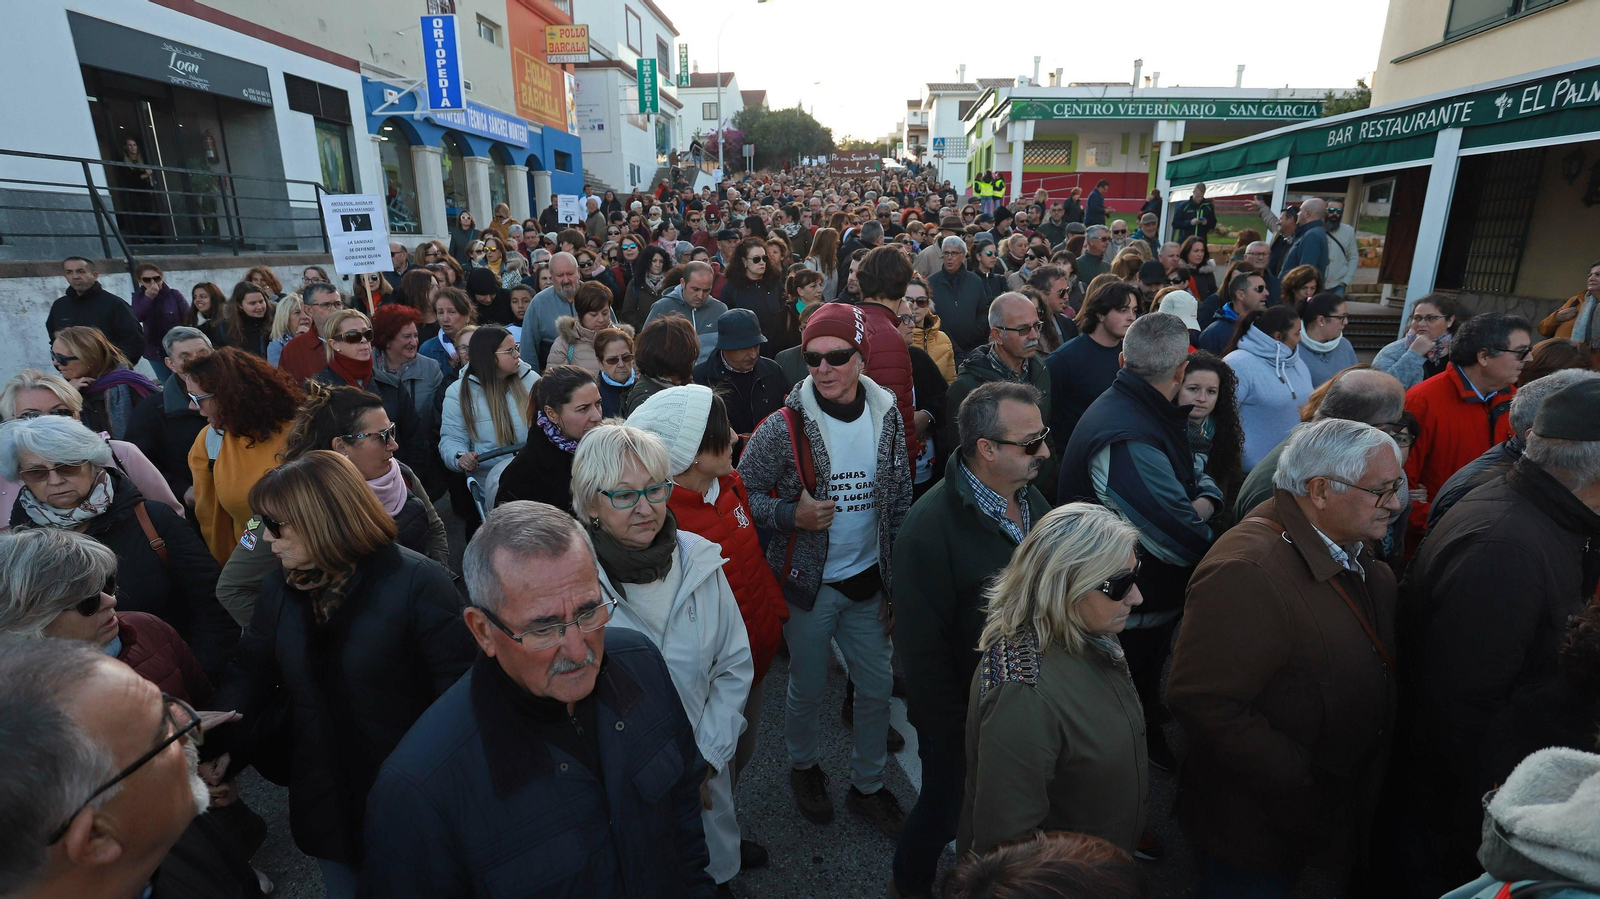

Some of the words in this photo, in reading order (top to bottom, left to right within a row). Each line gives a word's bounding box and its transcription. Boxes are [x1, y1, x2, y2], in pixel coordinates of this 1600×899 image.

[559, 28, 586, 38] POLLO
[549, 42, 586, 52] BARCALA
[168, 52, 199, 75] Loan
[433, 18, 451, 108] ORTOPEDIA
[524, 58, 552, 92] POLLO
[643, 60, 654, 113] ORTOPEDIA
[521, 82, 560, 118] BARCALA
[1053, 103, 1113, 115] CENTRO
[1118, 103, 1216, 116] VETERINARIO
[1229, 104, 1259, 116] SAN
[1262, 104, 1317, 116] GARCIA
[1519, 84, 1546, 114] EL
[467, 107, 488, 132] TÉCNICA
[508, 121, 527, 143] MONTERO
[1327, 126, 1353, 147] BAR
[1359, 101, 1475, 139] RESTAURANTE
[830, 471, 866, 480] UCHAS
[856, 482, 876, 490] GAN
[844, 491, 876, 501] LUCHA
[846, 502, 875, 512] PERDI
